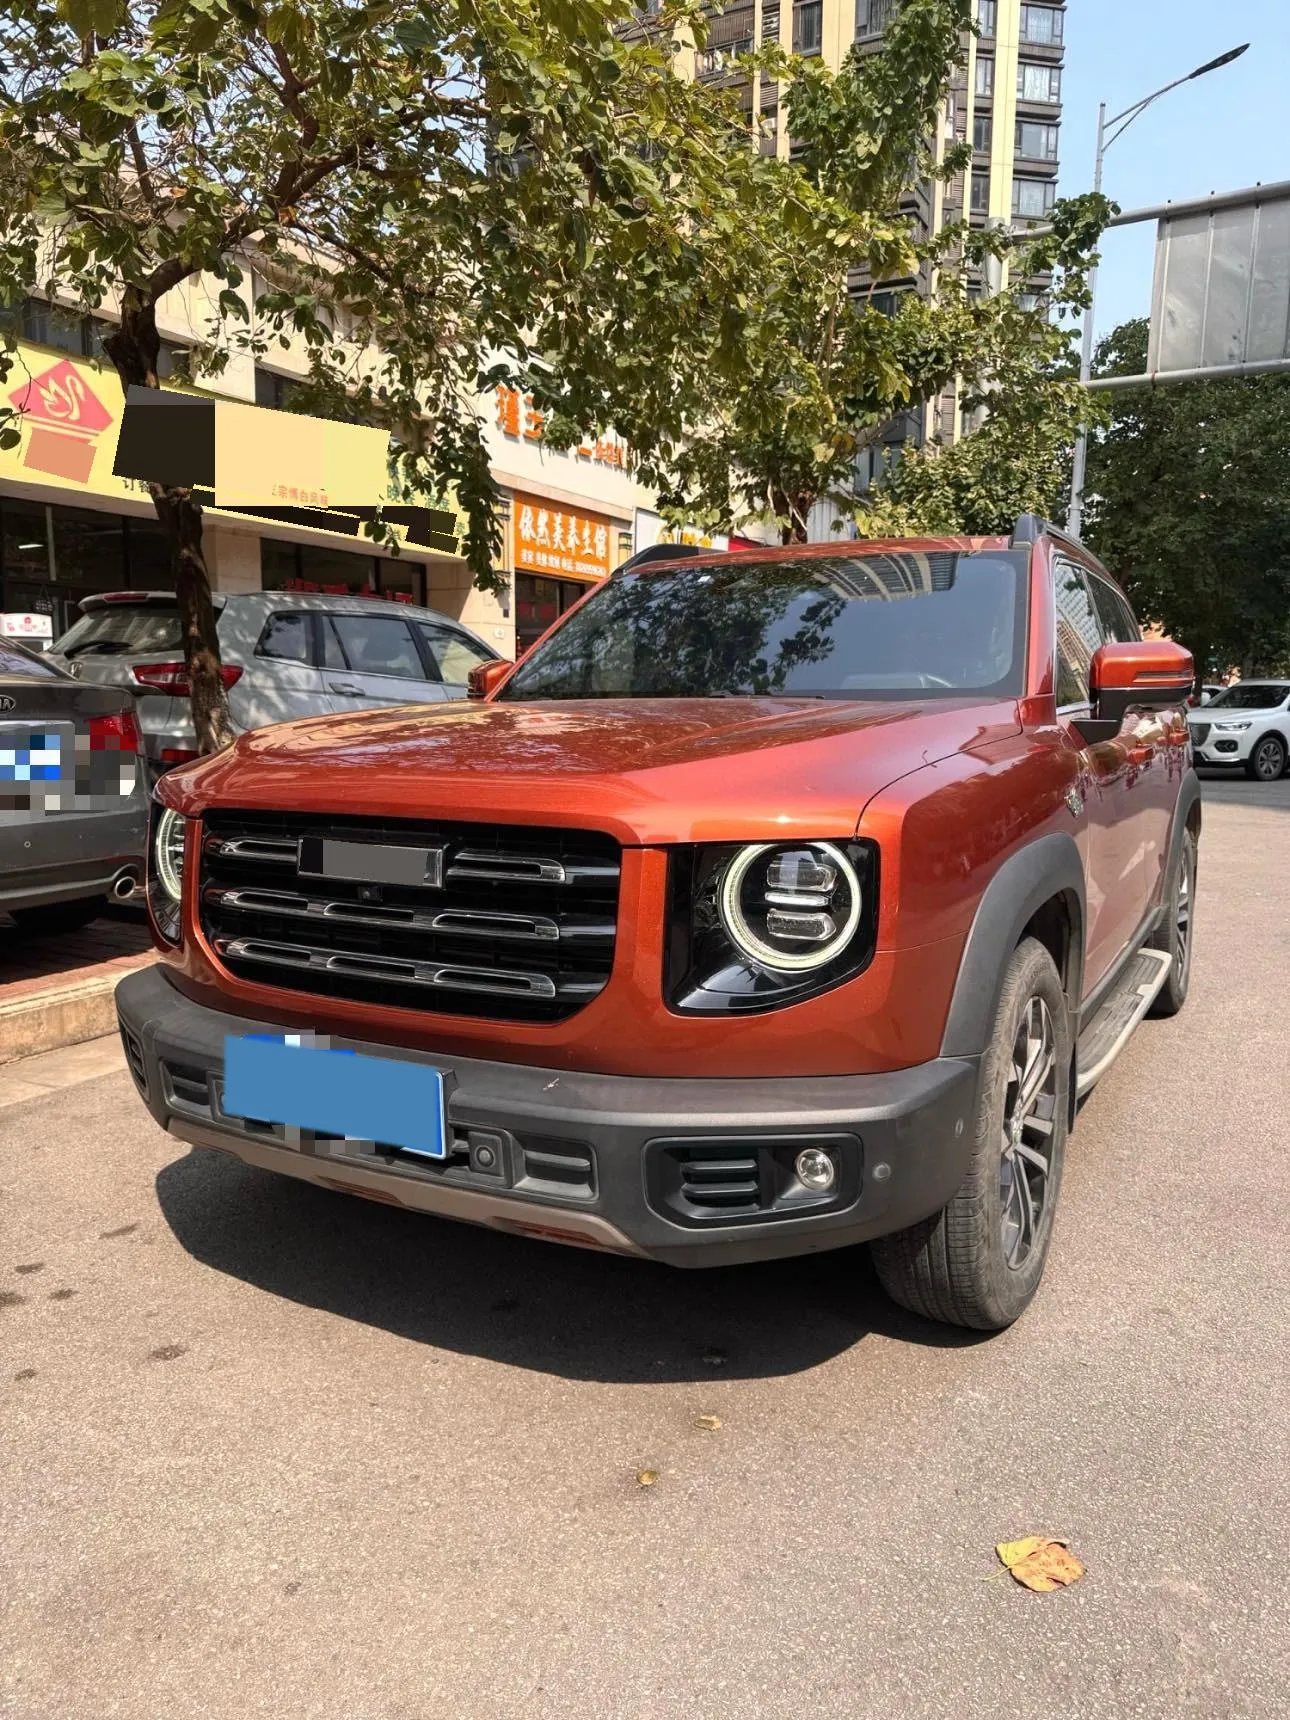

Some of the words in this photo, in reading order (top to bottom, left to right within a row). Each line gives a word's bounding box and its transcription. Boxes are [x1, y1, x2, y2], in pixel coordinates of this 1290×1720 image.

[519, 505, 607, 561] 依然美养生馆
